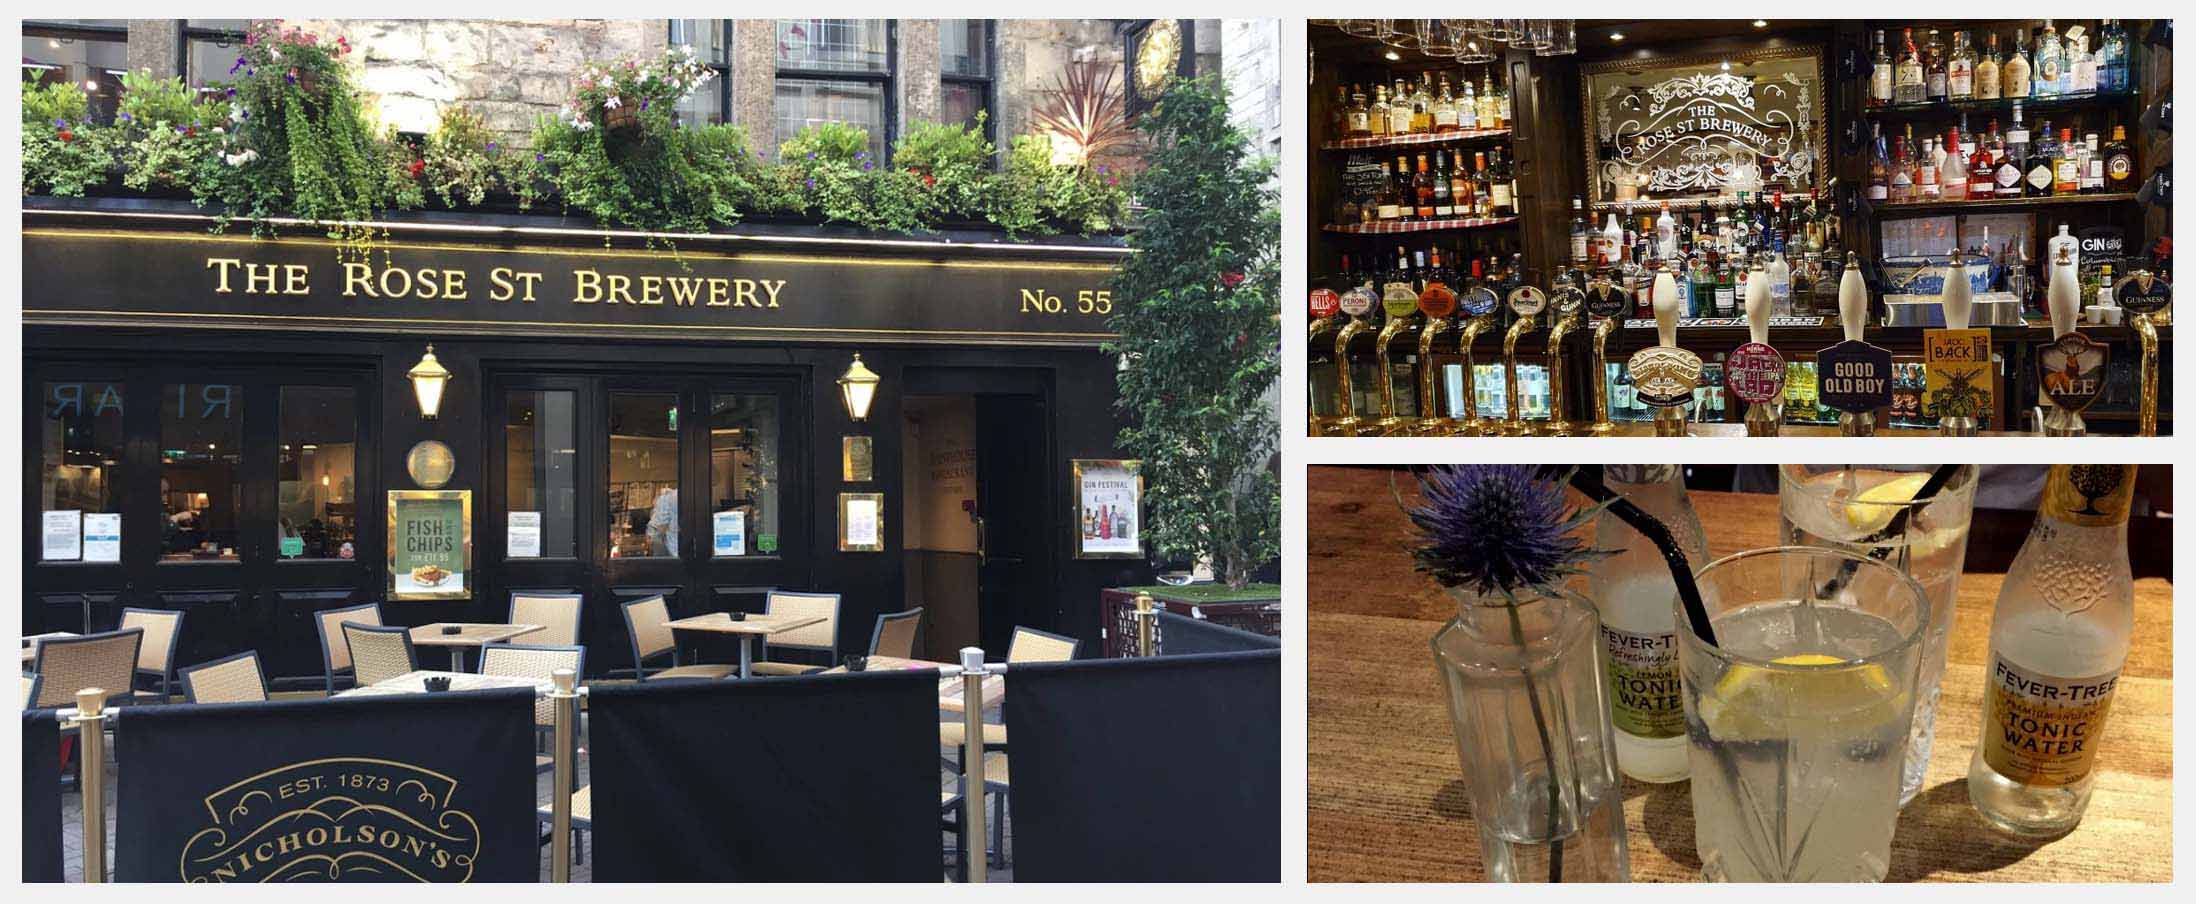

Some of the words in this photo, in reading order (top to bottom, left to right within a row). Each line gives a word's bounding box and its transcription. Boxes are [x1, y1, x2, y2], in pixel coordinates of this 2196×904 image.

[1688, 105, 1715, 118] THE
[1637, 126, 1674, 155] ROSE
[1676, 119, 1696, 134] ST
[1700, 117, 1772, 148] BREWERY
[2082, 239, 2105, 251] GIN
[207, 258, 311, 294] THE
[342, 262, 467, 299] ROSE
[489, 268, 543, 302] ST
[573, 270, 787, 308] BREWERY
[1019, 288, 1068, 313] No.
[1078, 290, 1112, 314] 55
[1311, 295, 1330, 310] HELLS
[1343, 296, 1367, 305] PERONI
[1560, 299, 1581, 312] GUNN
[2125, 295, 2165, 304] GUINNESS
[1935, 346, 1971, 359] BACK
[1835, 362, 1874, 378] GOOD
[1825, 378, 1852, 394] OLD
[1855, 378, 1886, 394] BOY
[2050, 379, 2096, 396] ALE
[1097, 480, 1129, 489] FESTIVAL
[407, 519, 443, 536] FISH
[407, 536, 452, 552] CHIPS
[1619, 691, 1681, 711] WATE
[2009, 712, 2087, 738] TONIC
[2004, 728, 2083, 755] WATER
[279, 776, 328, 800] EST.
[338, 774, 390, 792] 1873
[211, 825, 450, 883] NICHOLSON'S
